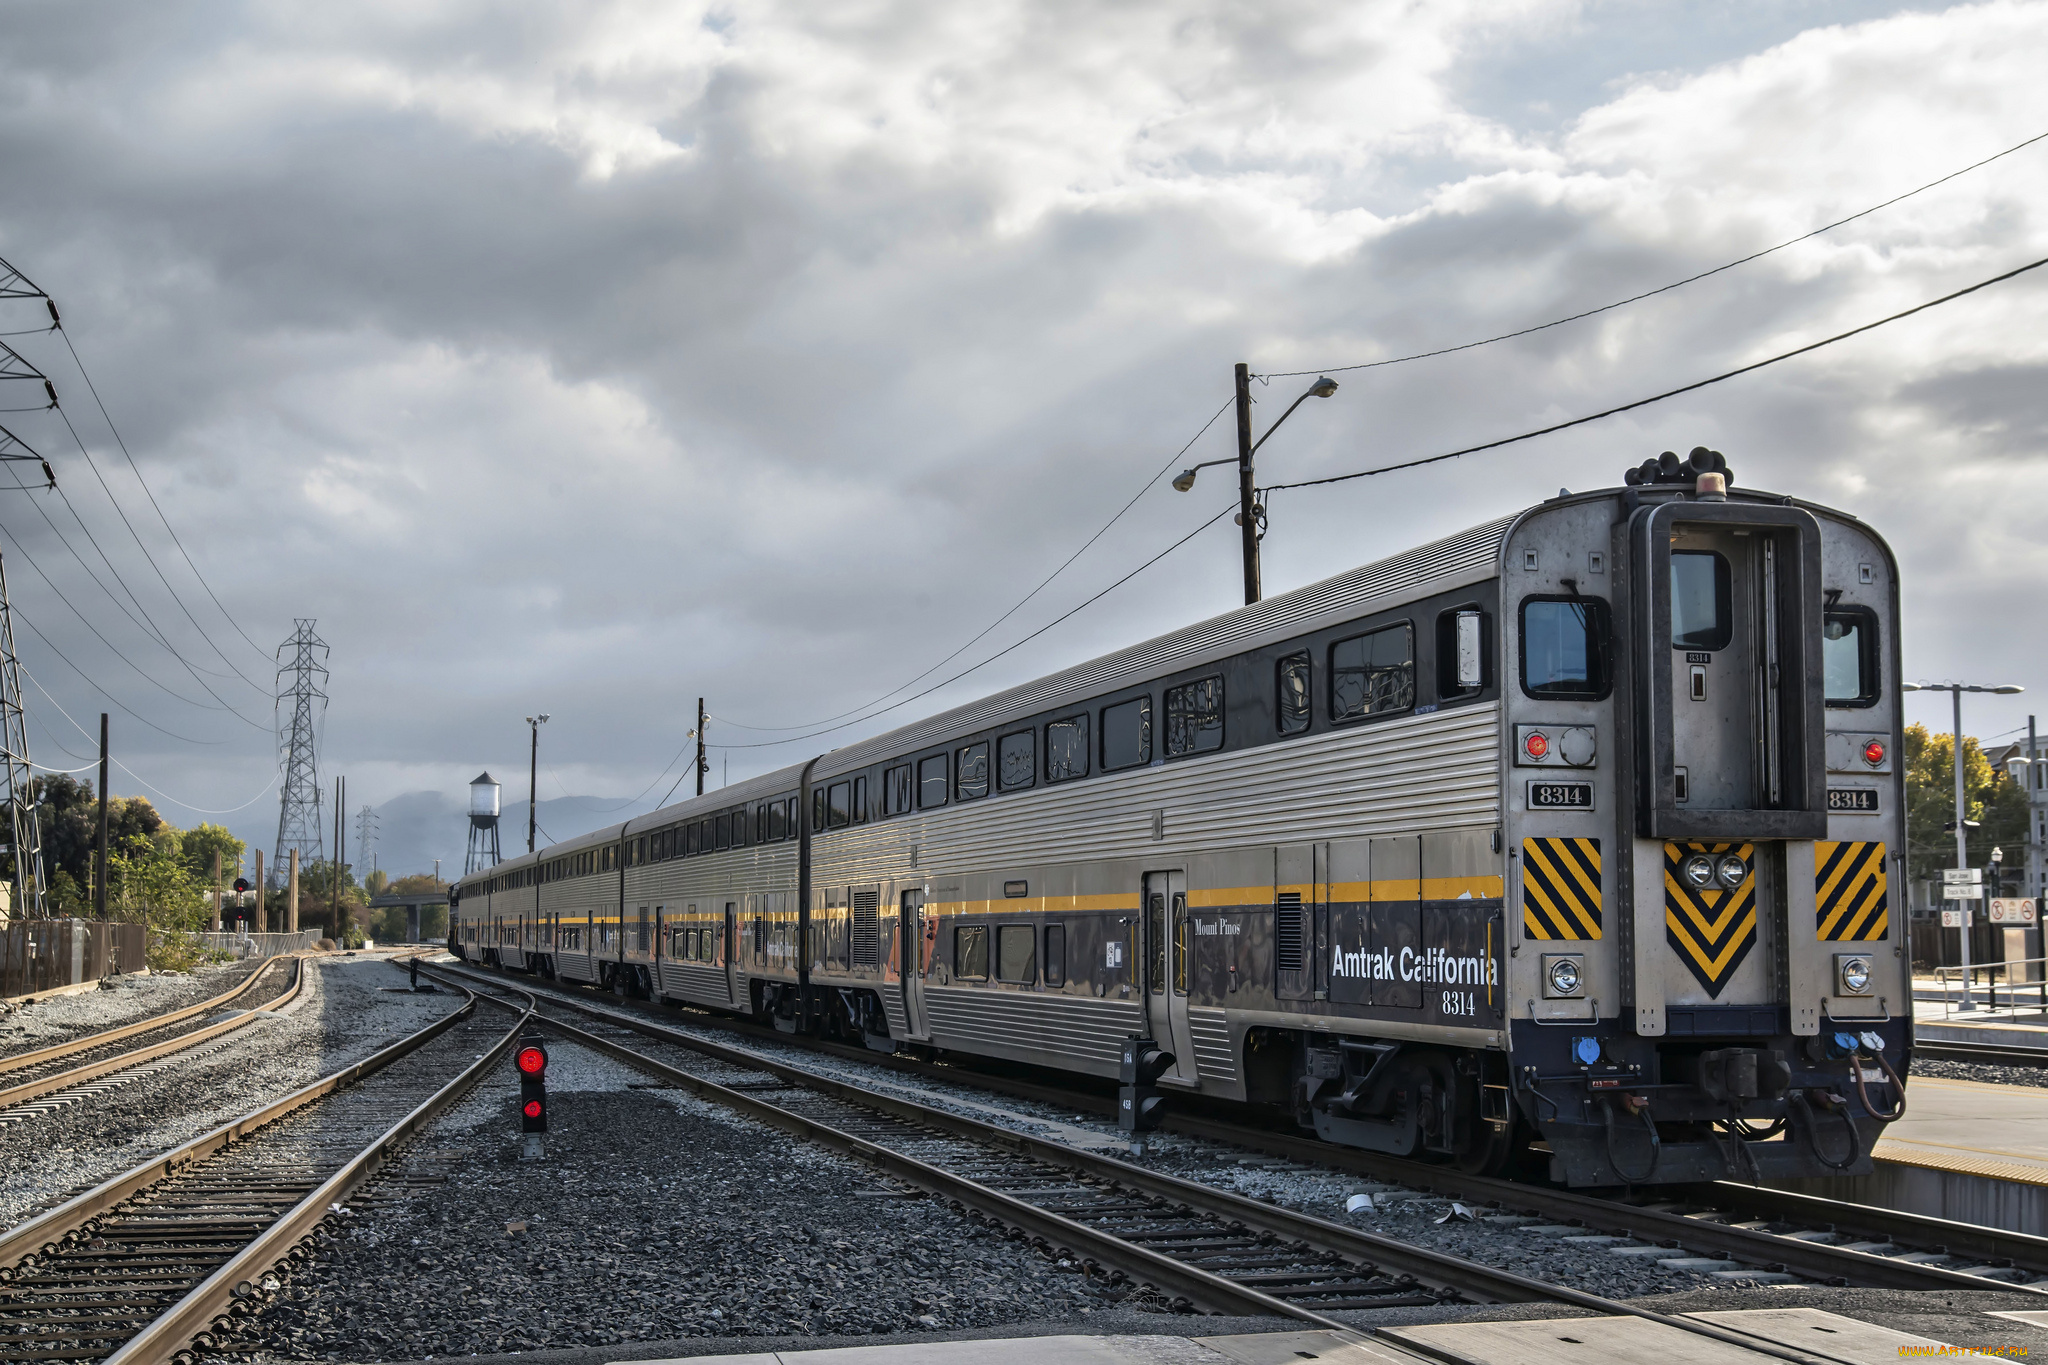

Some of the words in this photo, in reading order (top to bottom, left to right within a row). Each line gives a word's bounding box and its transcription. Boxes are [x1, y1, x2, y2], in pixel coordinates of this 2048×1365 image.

[1689, 653, 1708, 662] 8314
[1540, 786, 1583, 804] 8314
[1829, 791, 1870, 809] 8314
[1195, 918, 1218, 936] Mount
[1219, 917, 1241, 936] Pinos
[1332, 944, 1395, 981] Amtrak
[1399, 946, 1499, 986] California
[1442, 990, 1476, 1017] 8314
